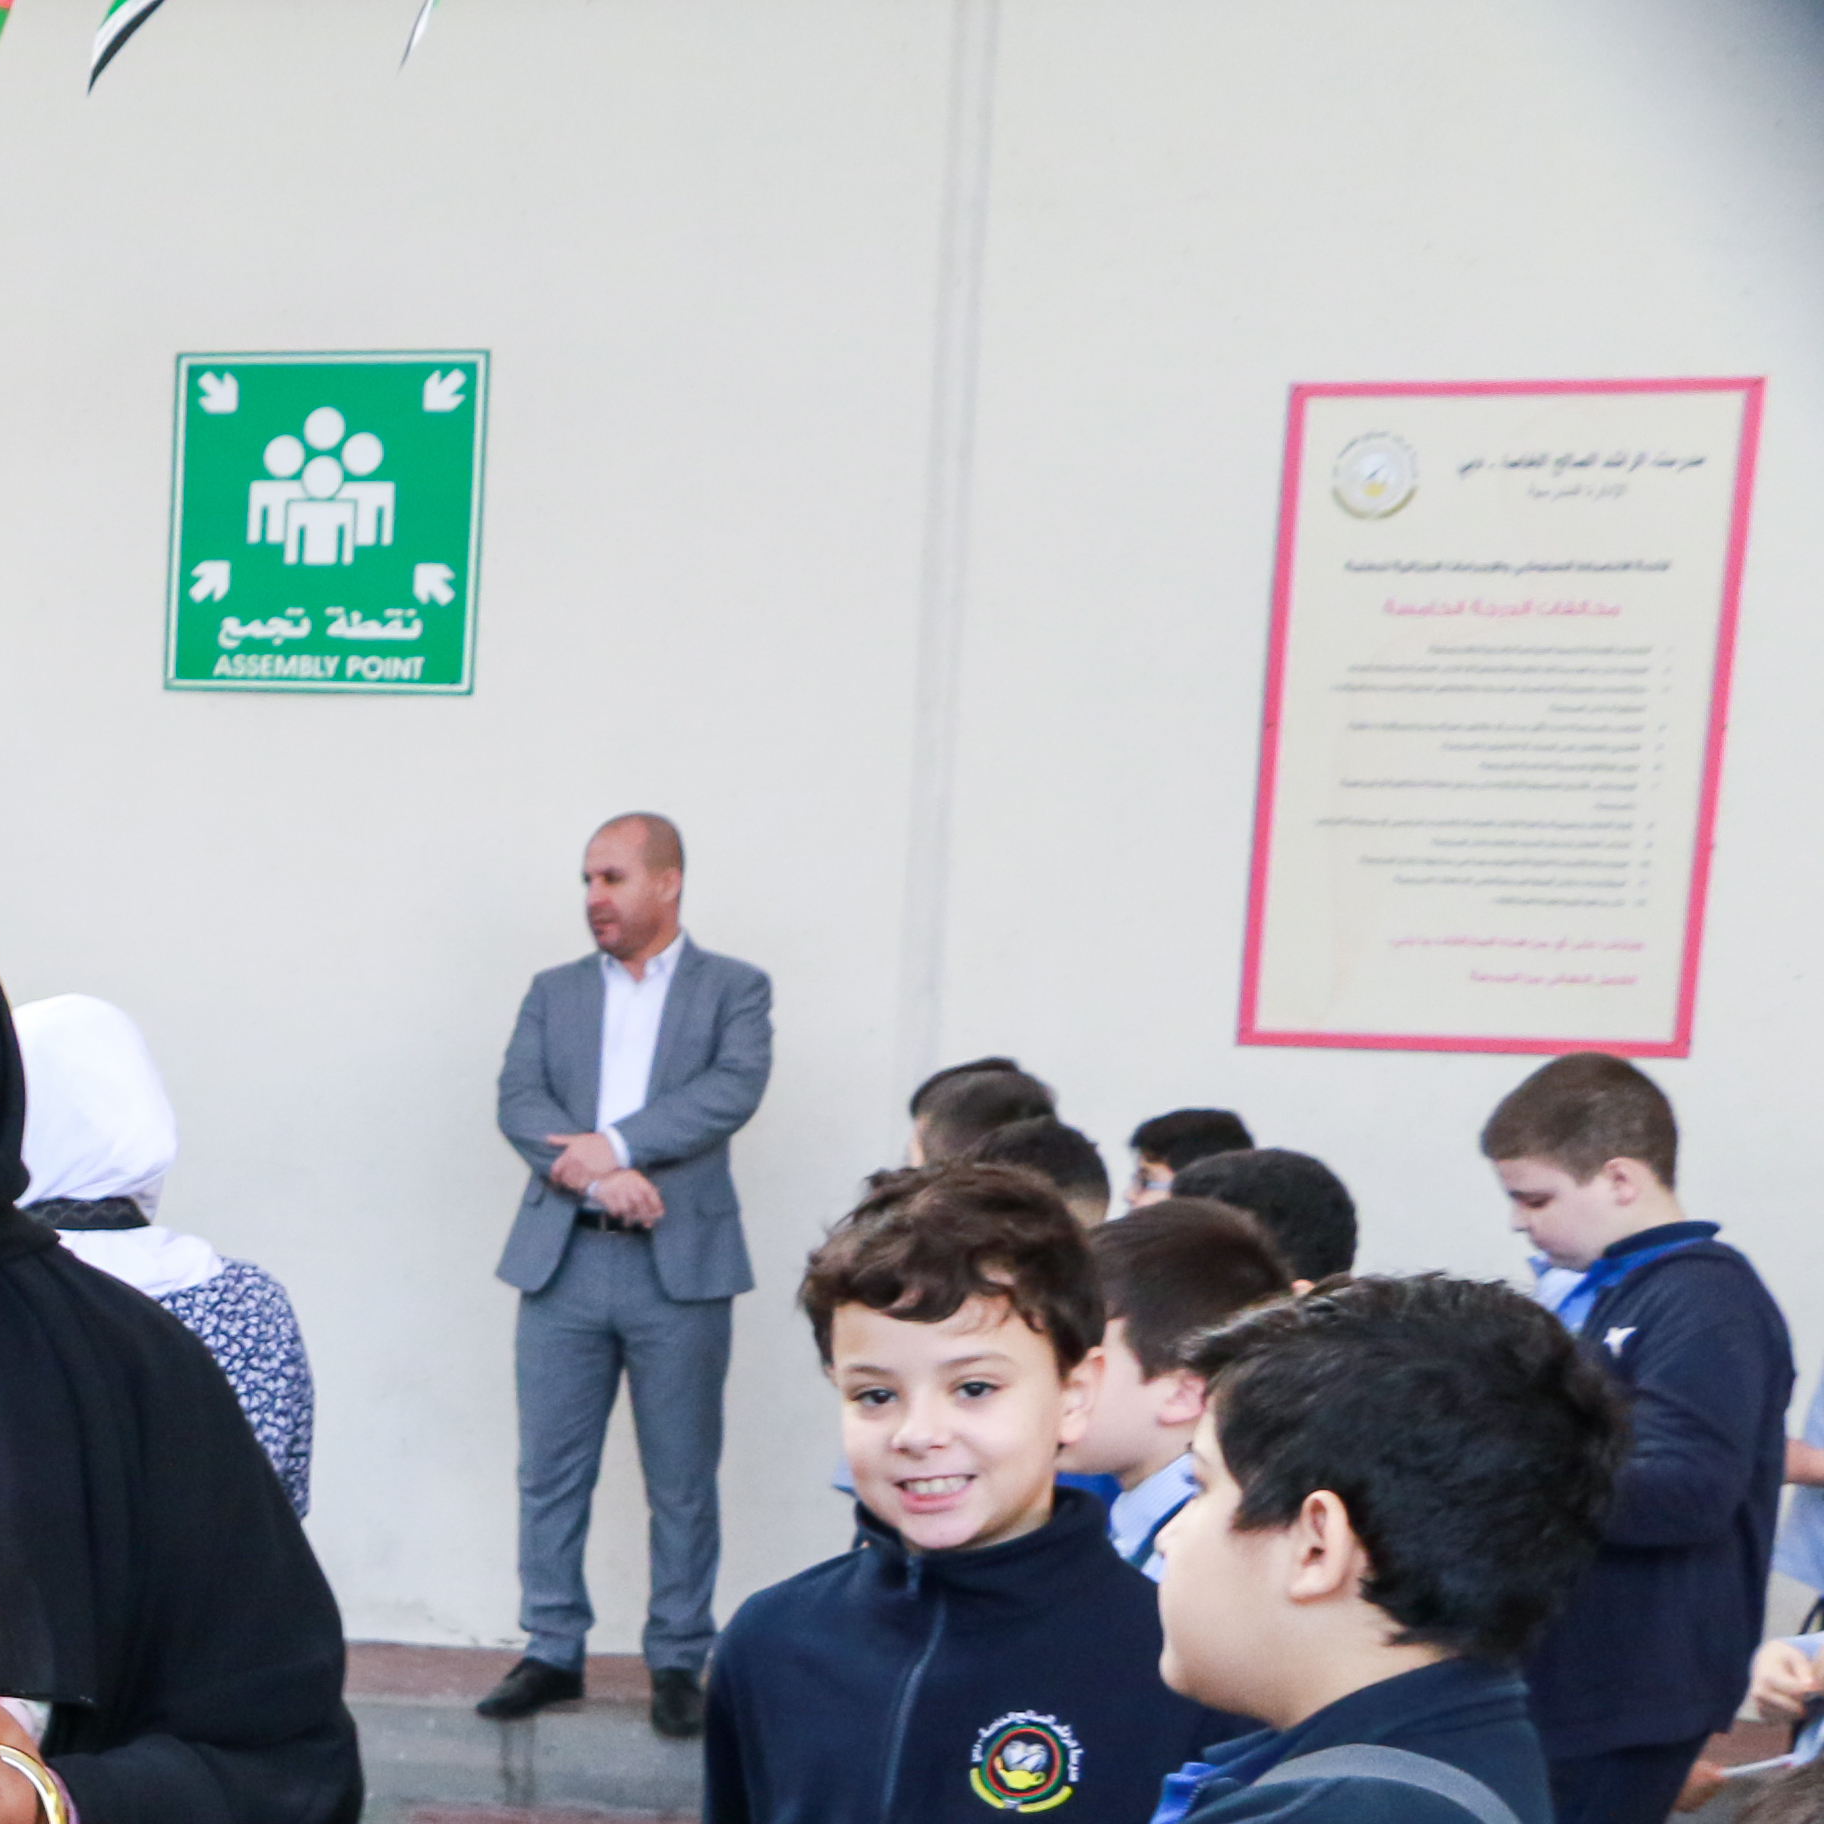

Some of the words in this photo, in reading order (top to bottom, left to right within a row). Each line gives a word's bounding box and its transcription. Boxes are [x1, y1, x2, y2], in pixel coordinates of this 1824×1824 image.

[217, 607, 312, 650] تجمع
[324, 606, 423, 641] نقطة
[213, 654, 340, 679] ASSEMBLY
[345, 655, 425, 680] POINT
